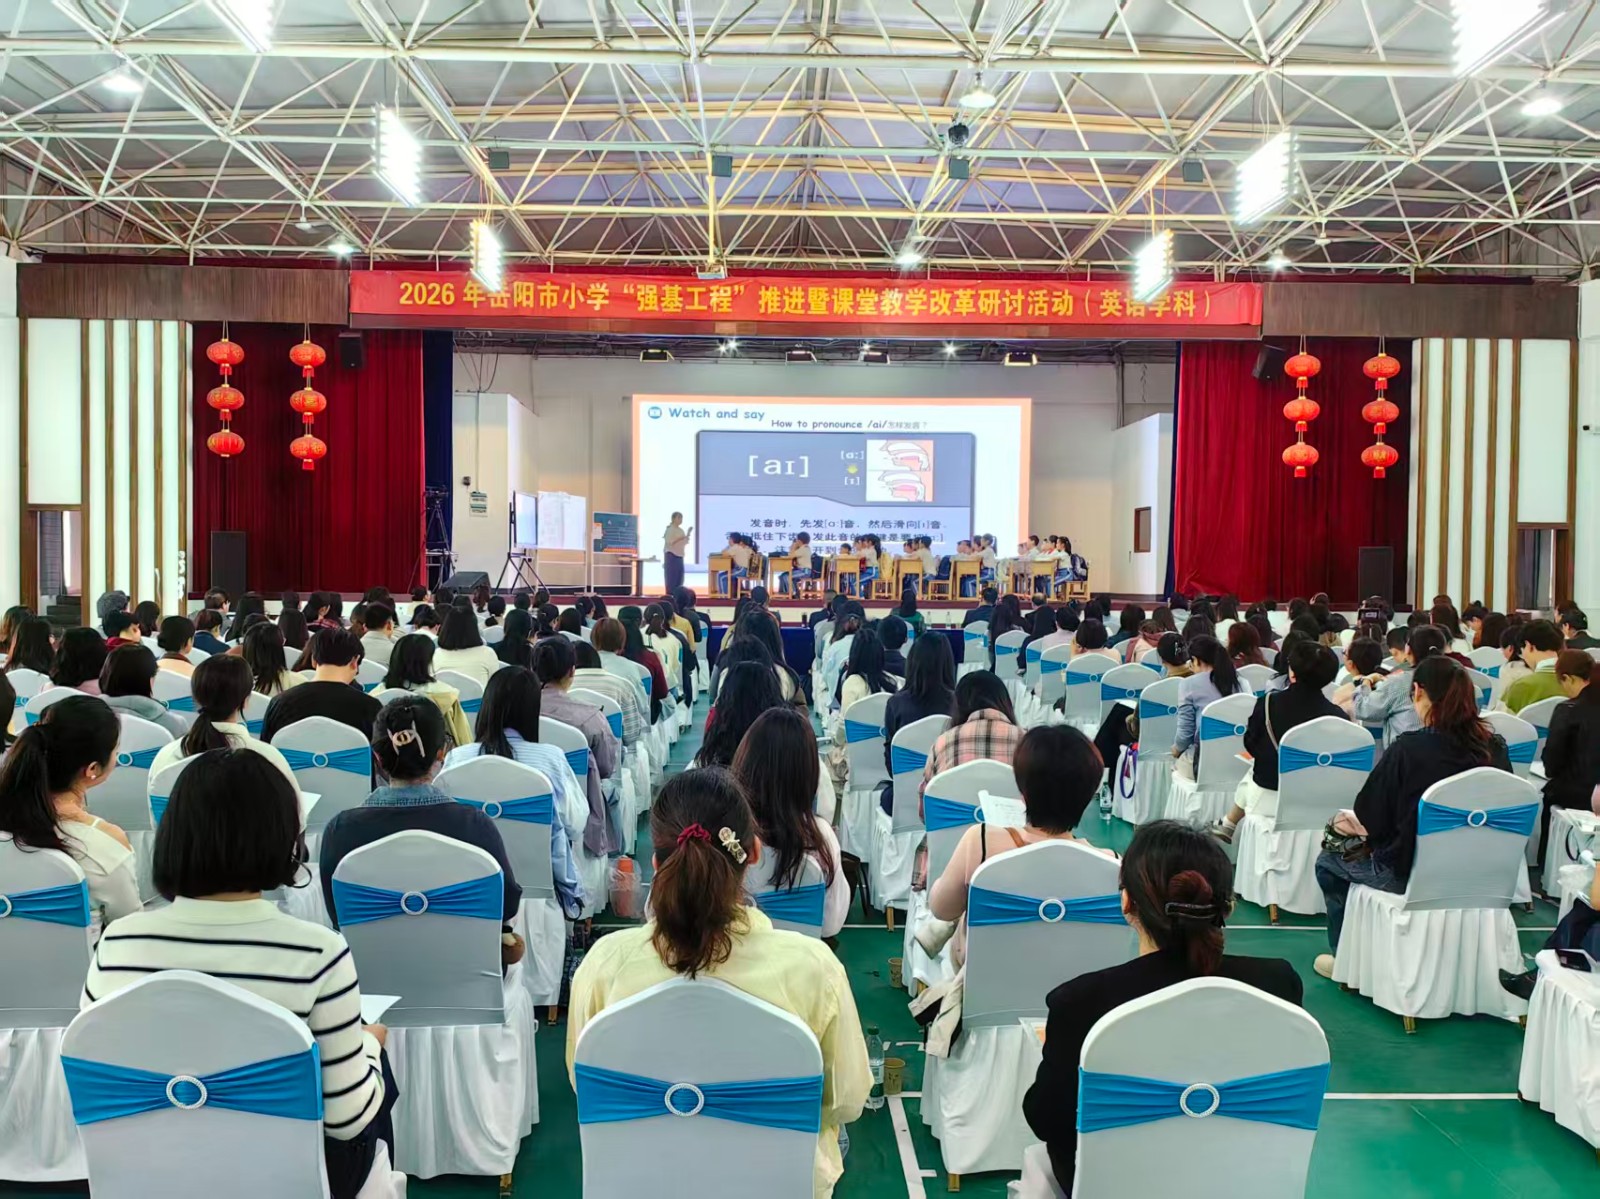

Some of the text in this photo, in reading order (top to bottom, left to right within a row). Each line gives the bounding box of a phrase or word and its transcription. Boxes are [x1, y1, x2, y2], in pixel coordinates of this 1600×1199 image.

[400, 281, 456, 306] 2026
[668, 407, 766, 422] Watch and say
[771, 419, 792, 428] How
[797, 419, 808, 428] to
[812, 420, 863, 430] pronounce
